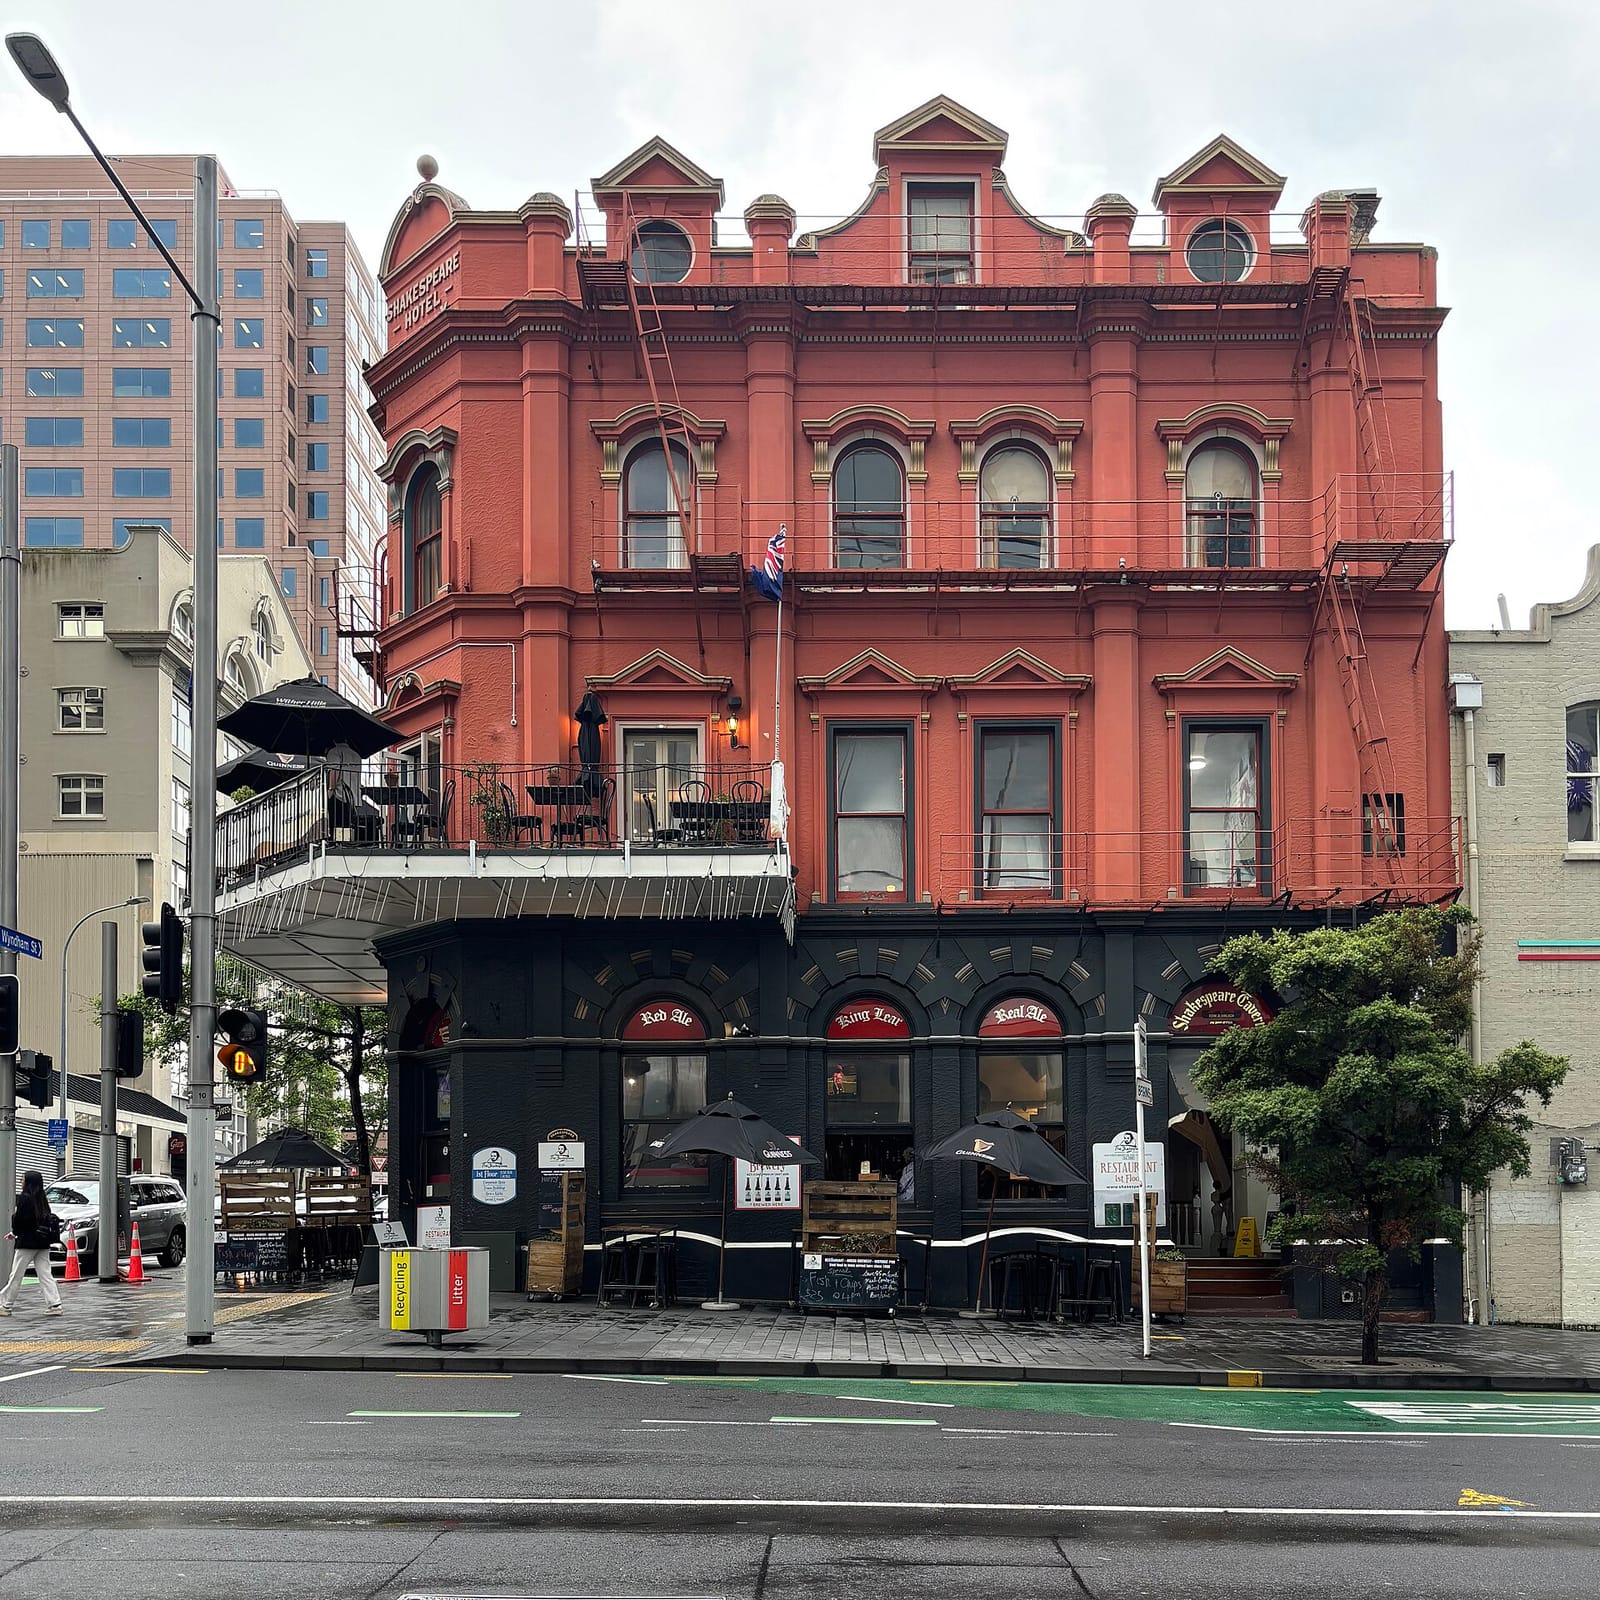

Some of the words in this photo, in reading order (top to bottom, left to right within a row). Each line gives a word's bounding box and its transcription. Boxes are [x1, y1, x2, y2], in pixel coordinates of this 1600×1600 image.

[385, 251, 460, 322] SHAKESPEARE
[404, 290, 441, 331] HOTEL
[266, 760, 305, 769] GUINNESS
[1, 929, 30, 951] Wyndham
[30, 940, 38, 954] St
[640, 1009, 667, 1026] Red
[670, 1008, 693, 1026] Ale
[835, 1009, 870, 1029] King
[993, 1005, 1025, 1025] Real
[1025, 1005, 1048, 1023] Ale
[1172, 991, 1236, 1031] Shakespeare
[198, 1092, 207, 1100] 10
[763, 1150, 793, 1158] GUINNESS
[1125, 1174, 1141, 1184] Floo
[395, 1262, 408, 1317] Recycling
[453, 1274, 463, 1305] Litter
[809, 1271, 831, 1289] Fish
